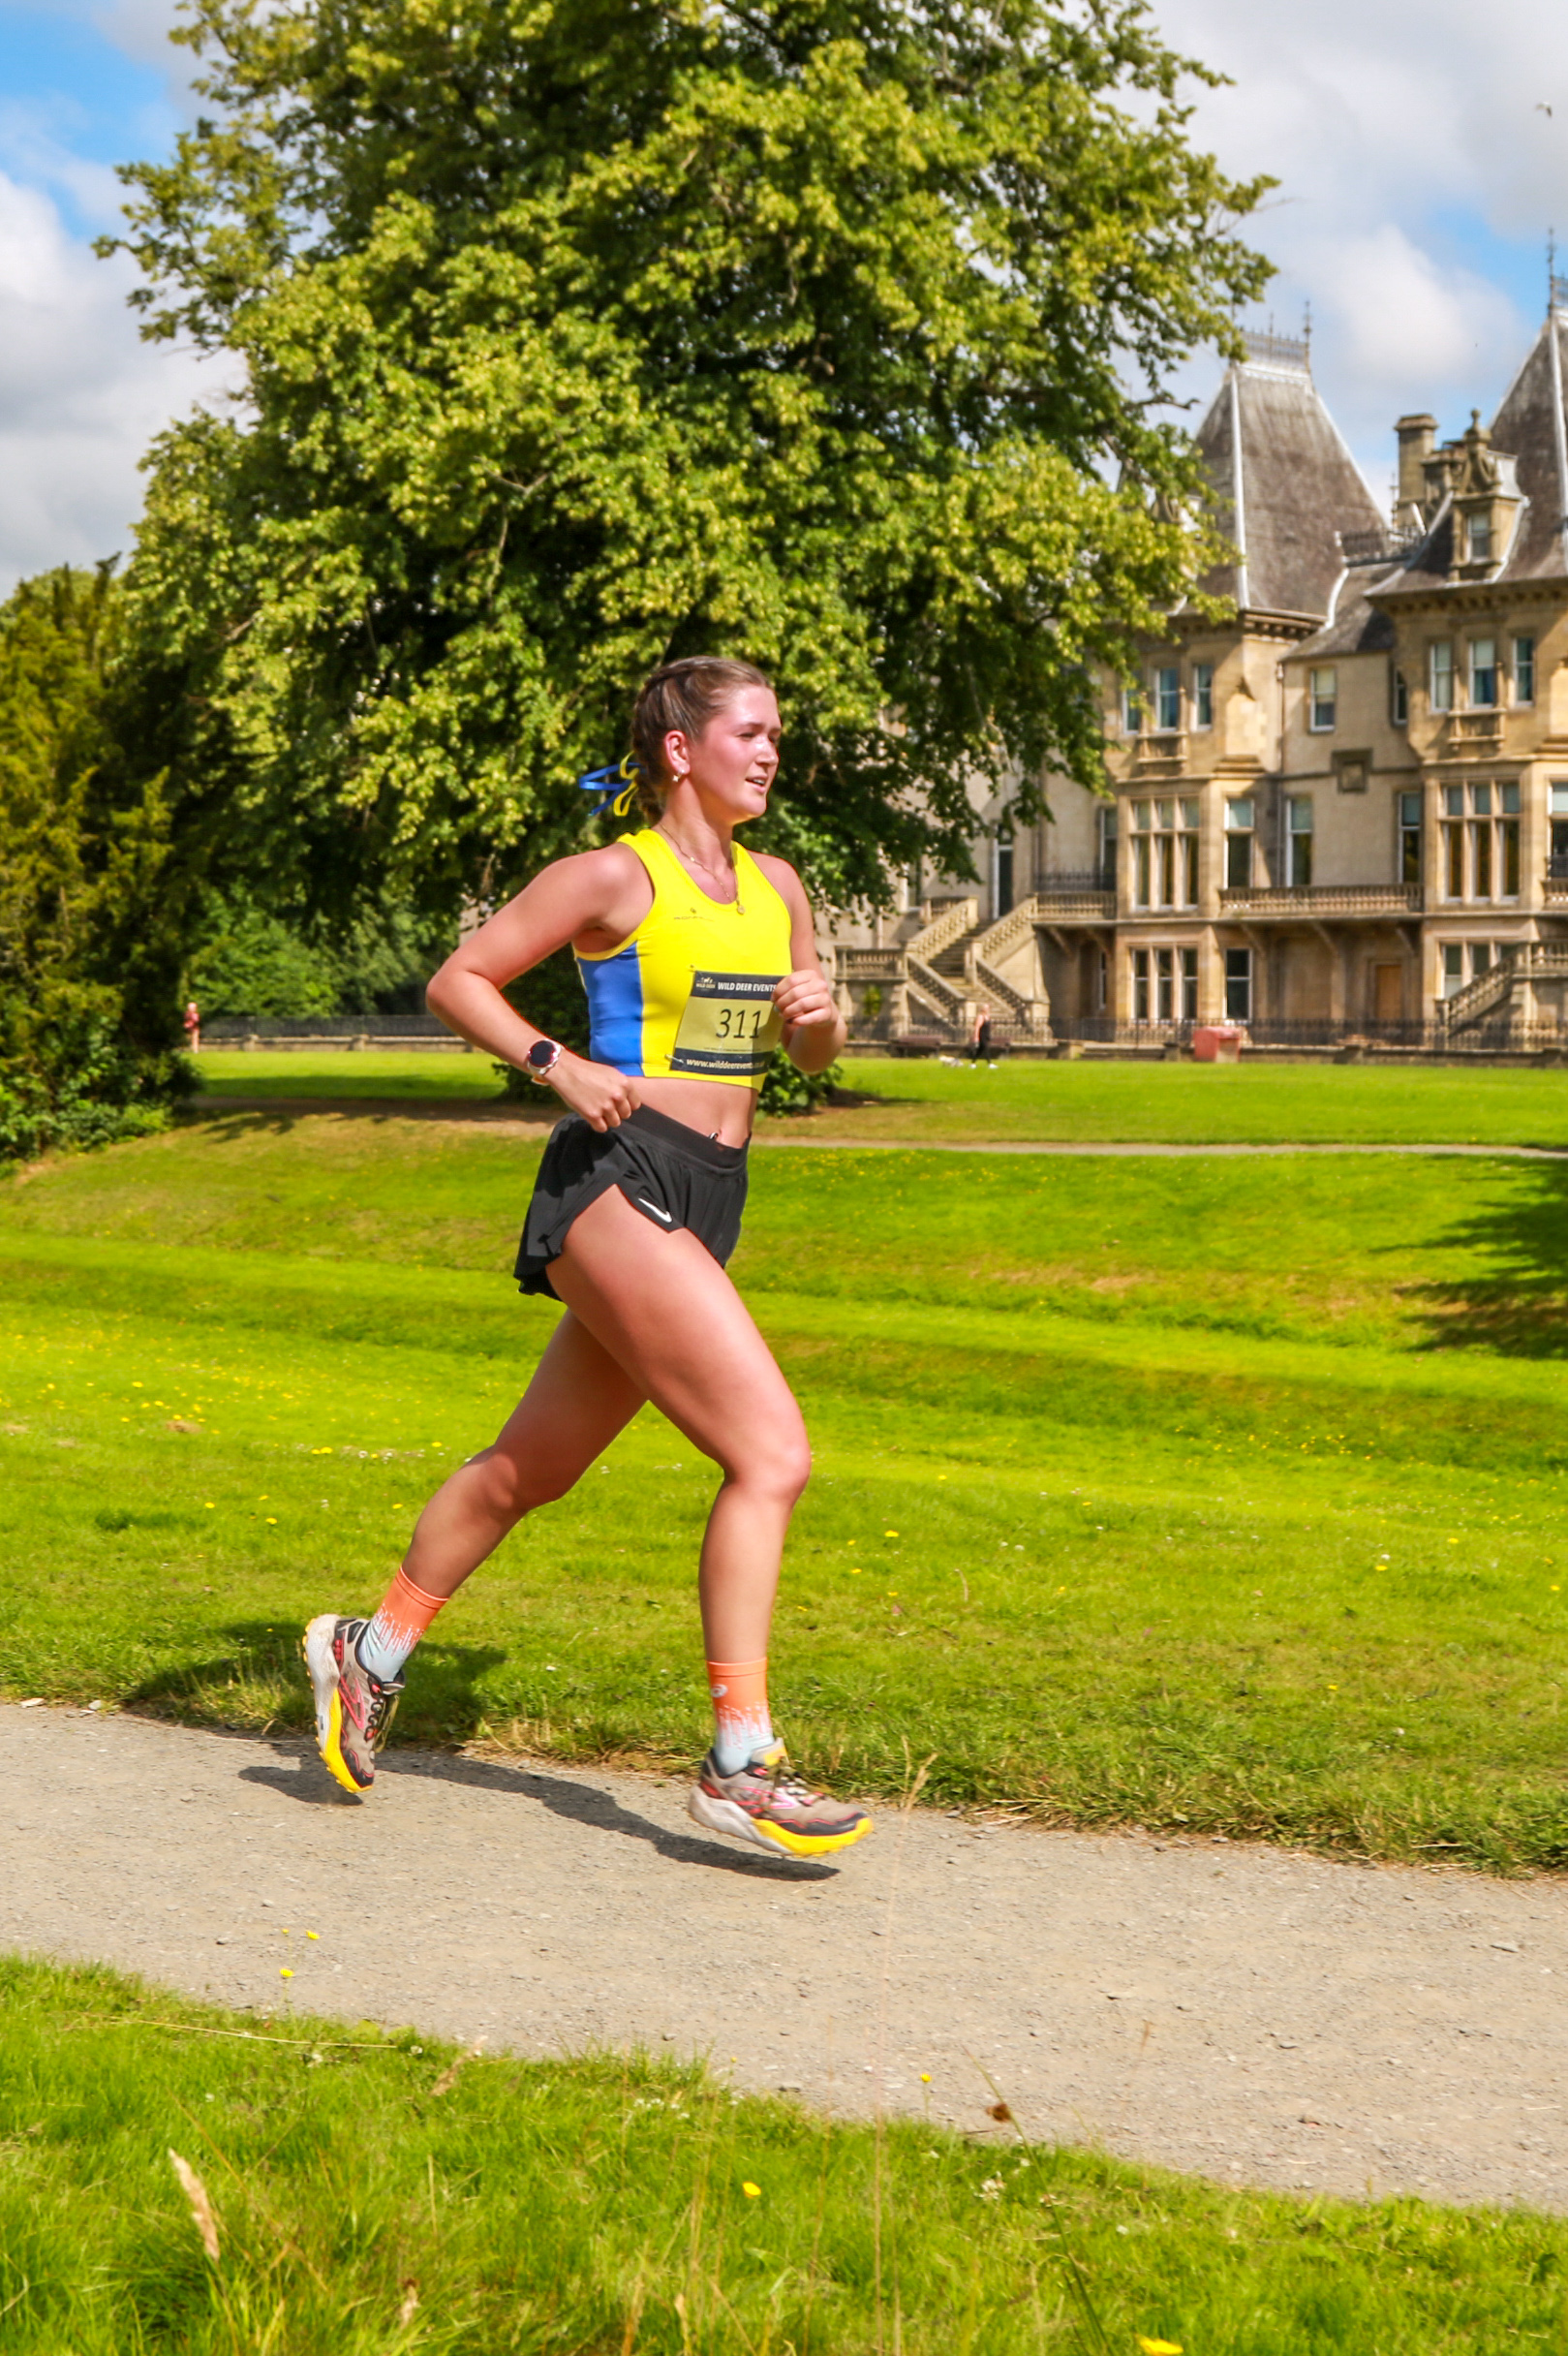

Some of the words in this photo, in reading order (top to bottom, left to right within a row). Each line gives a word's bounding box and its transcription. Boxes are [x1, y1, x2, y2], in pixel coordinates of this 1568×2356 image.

[718, 981, 735, 991] WILD
[735, 982, 753, 991] DEER
[716, 1008, 761, 1038] 311
